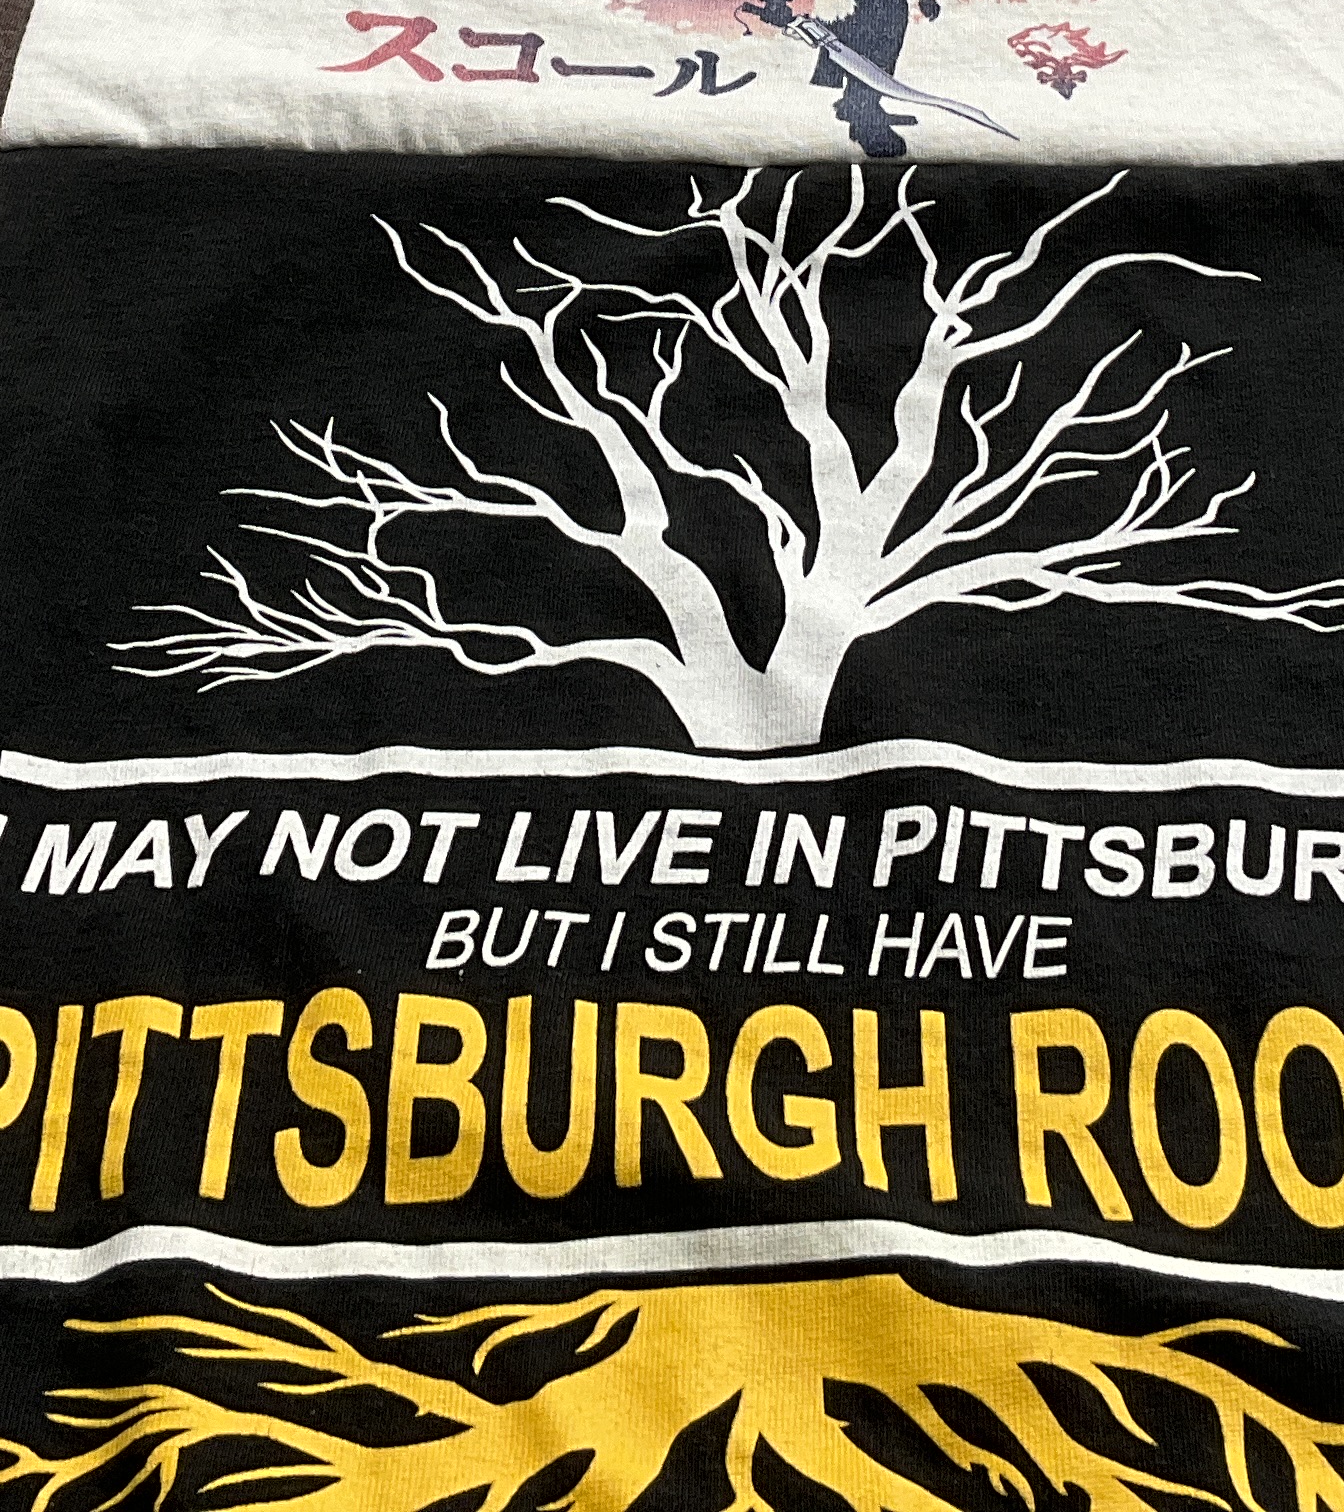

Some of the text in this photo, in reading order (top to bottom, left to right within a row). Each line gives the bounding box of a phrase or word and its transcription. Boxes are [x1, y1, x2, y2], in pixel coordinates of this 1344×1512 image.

[321, 8, 757, 99] スコール
[22, 809, 244, 900] MAY
[260, 809, 484, 883] NOT
[495, 809, 722, 886] LIVE
[746, 809, 842, 886] IN
[425, 912, 1072, 982] BUT I STILL HAVE
